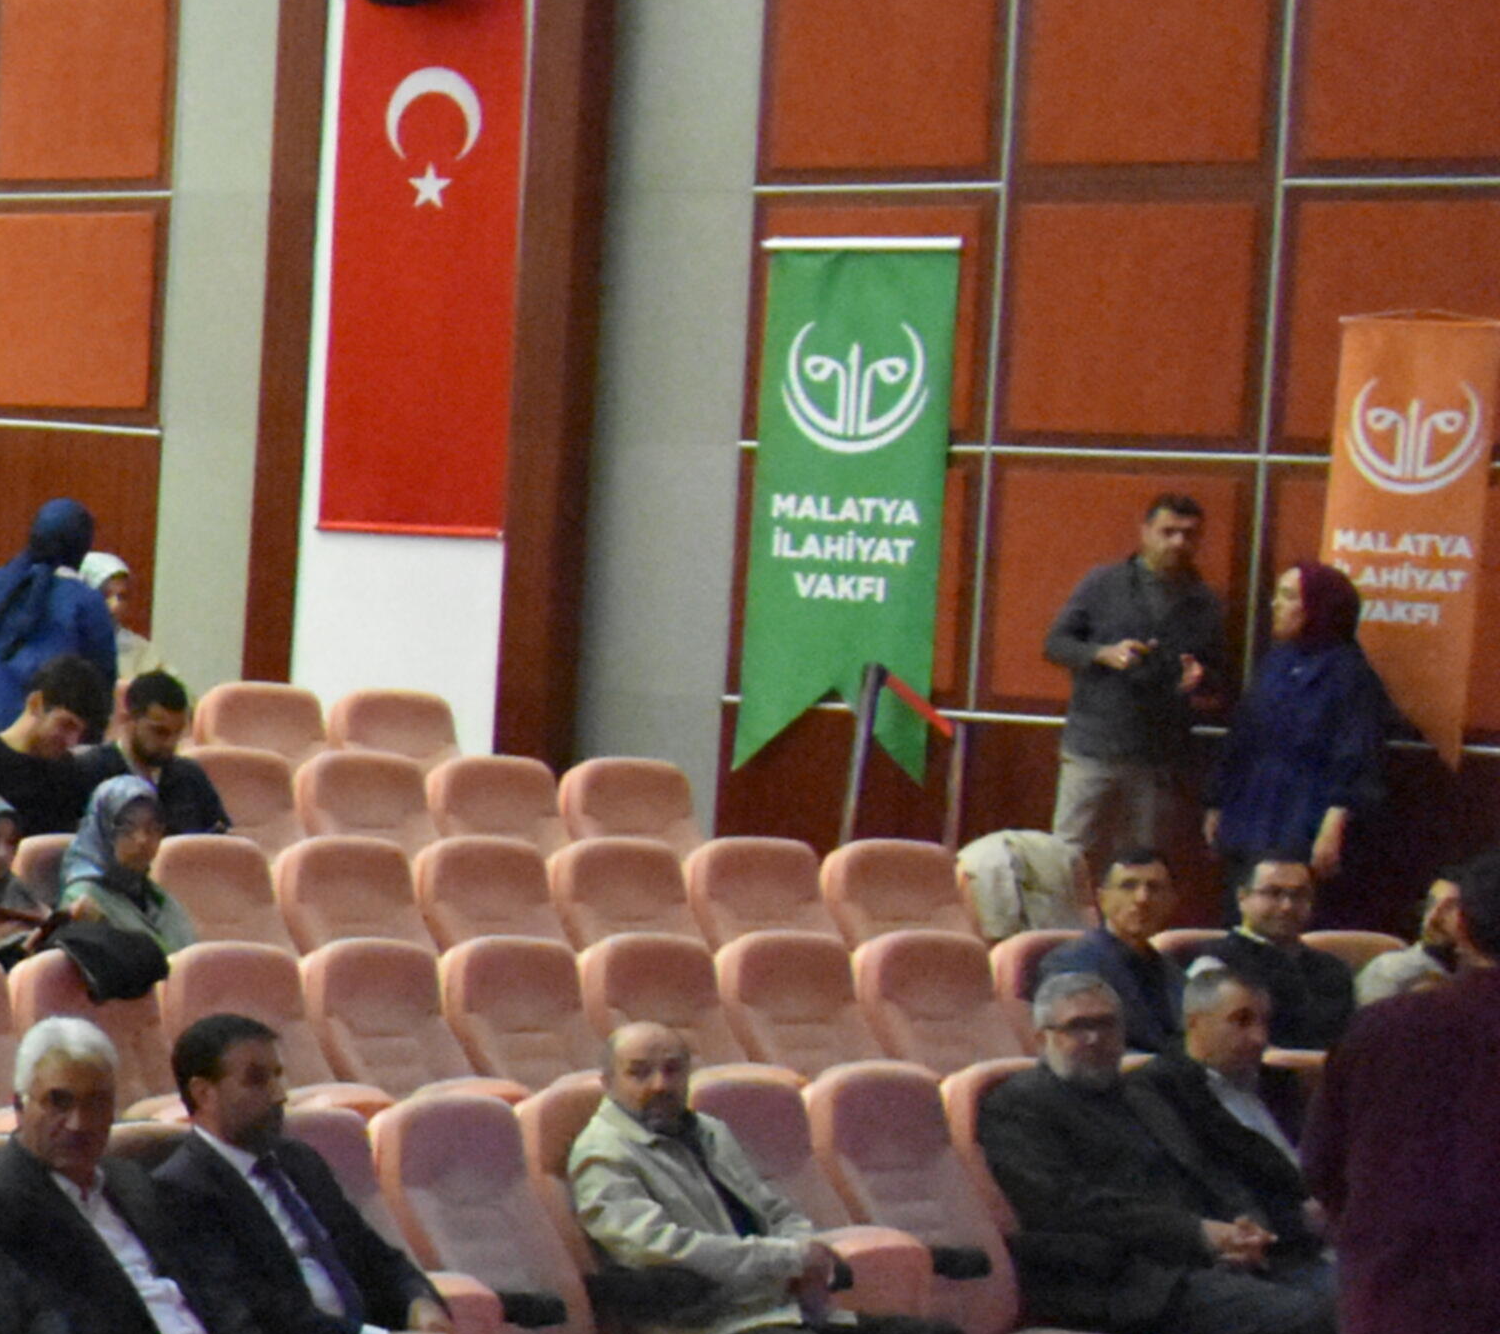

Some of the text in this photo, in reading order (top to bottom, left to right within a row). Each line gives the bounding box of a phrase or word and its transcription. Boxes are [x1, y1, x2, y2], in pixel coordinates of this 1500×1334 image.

[771, 493, 921, 526] MALATYA
[771, 526, 916, 565] İLAHİYAT
[1332, 529, 1474, 559] MALATYA
[793, 571, 887, 603] VAKFI
